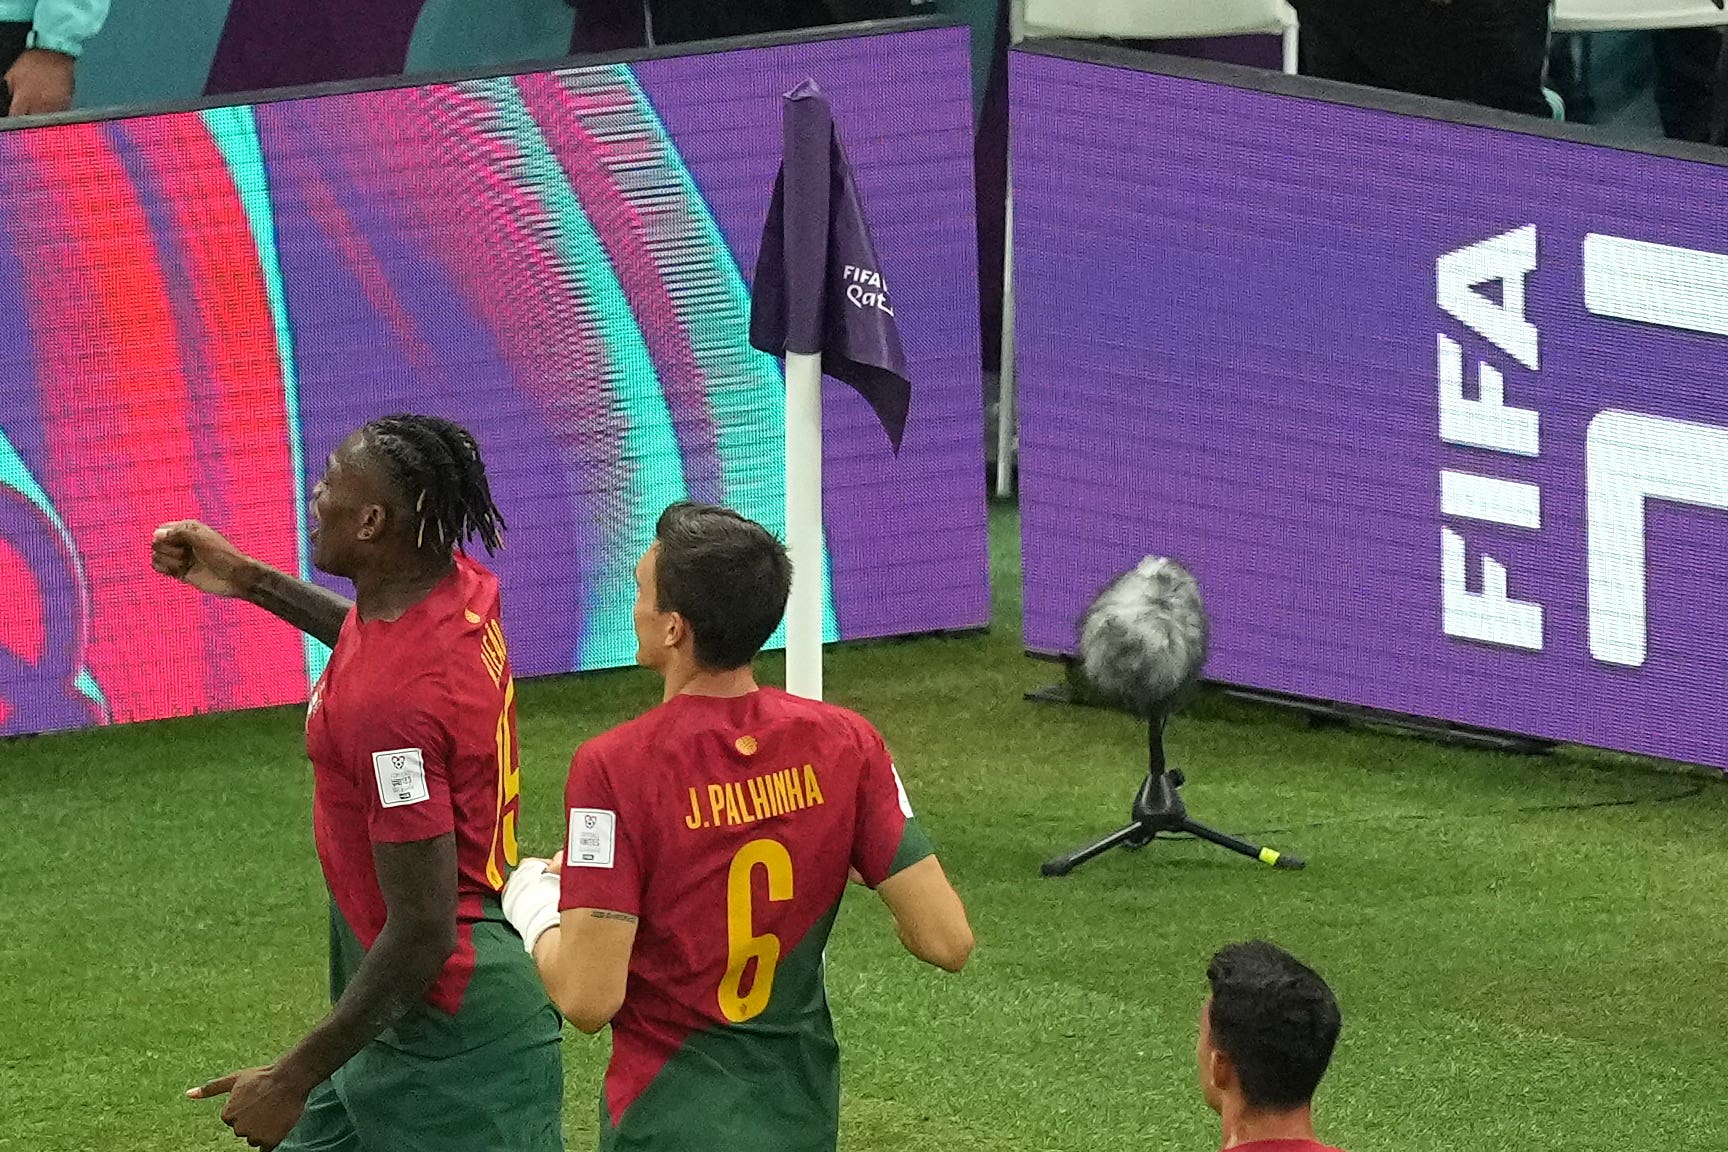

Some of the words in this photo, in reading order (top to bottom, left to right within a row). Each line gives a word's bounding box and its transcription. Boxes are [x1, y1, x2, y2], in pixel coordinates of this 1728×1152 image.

[843, 264, 881, 288] FIFA
[1435, 223, 1544, 651] FIFA
[685, 763, 824, 830] J.PALHINHA
[717, 838, 794, 1023] 6
